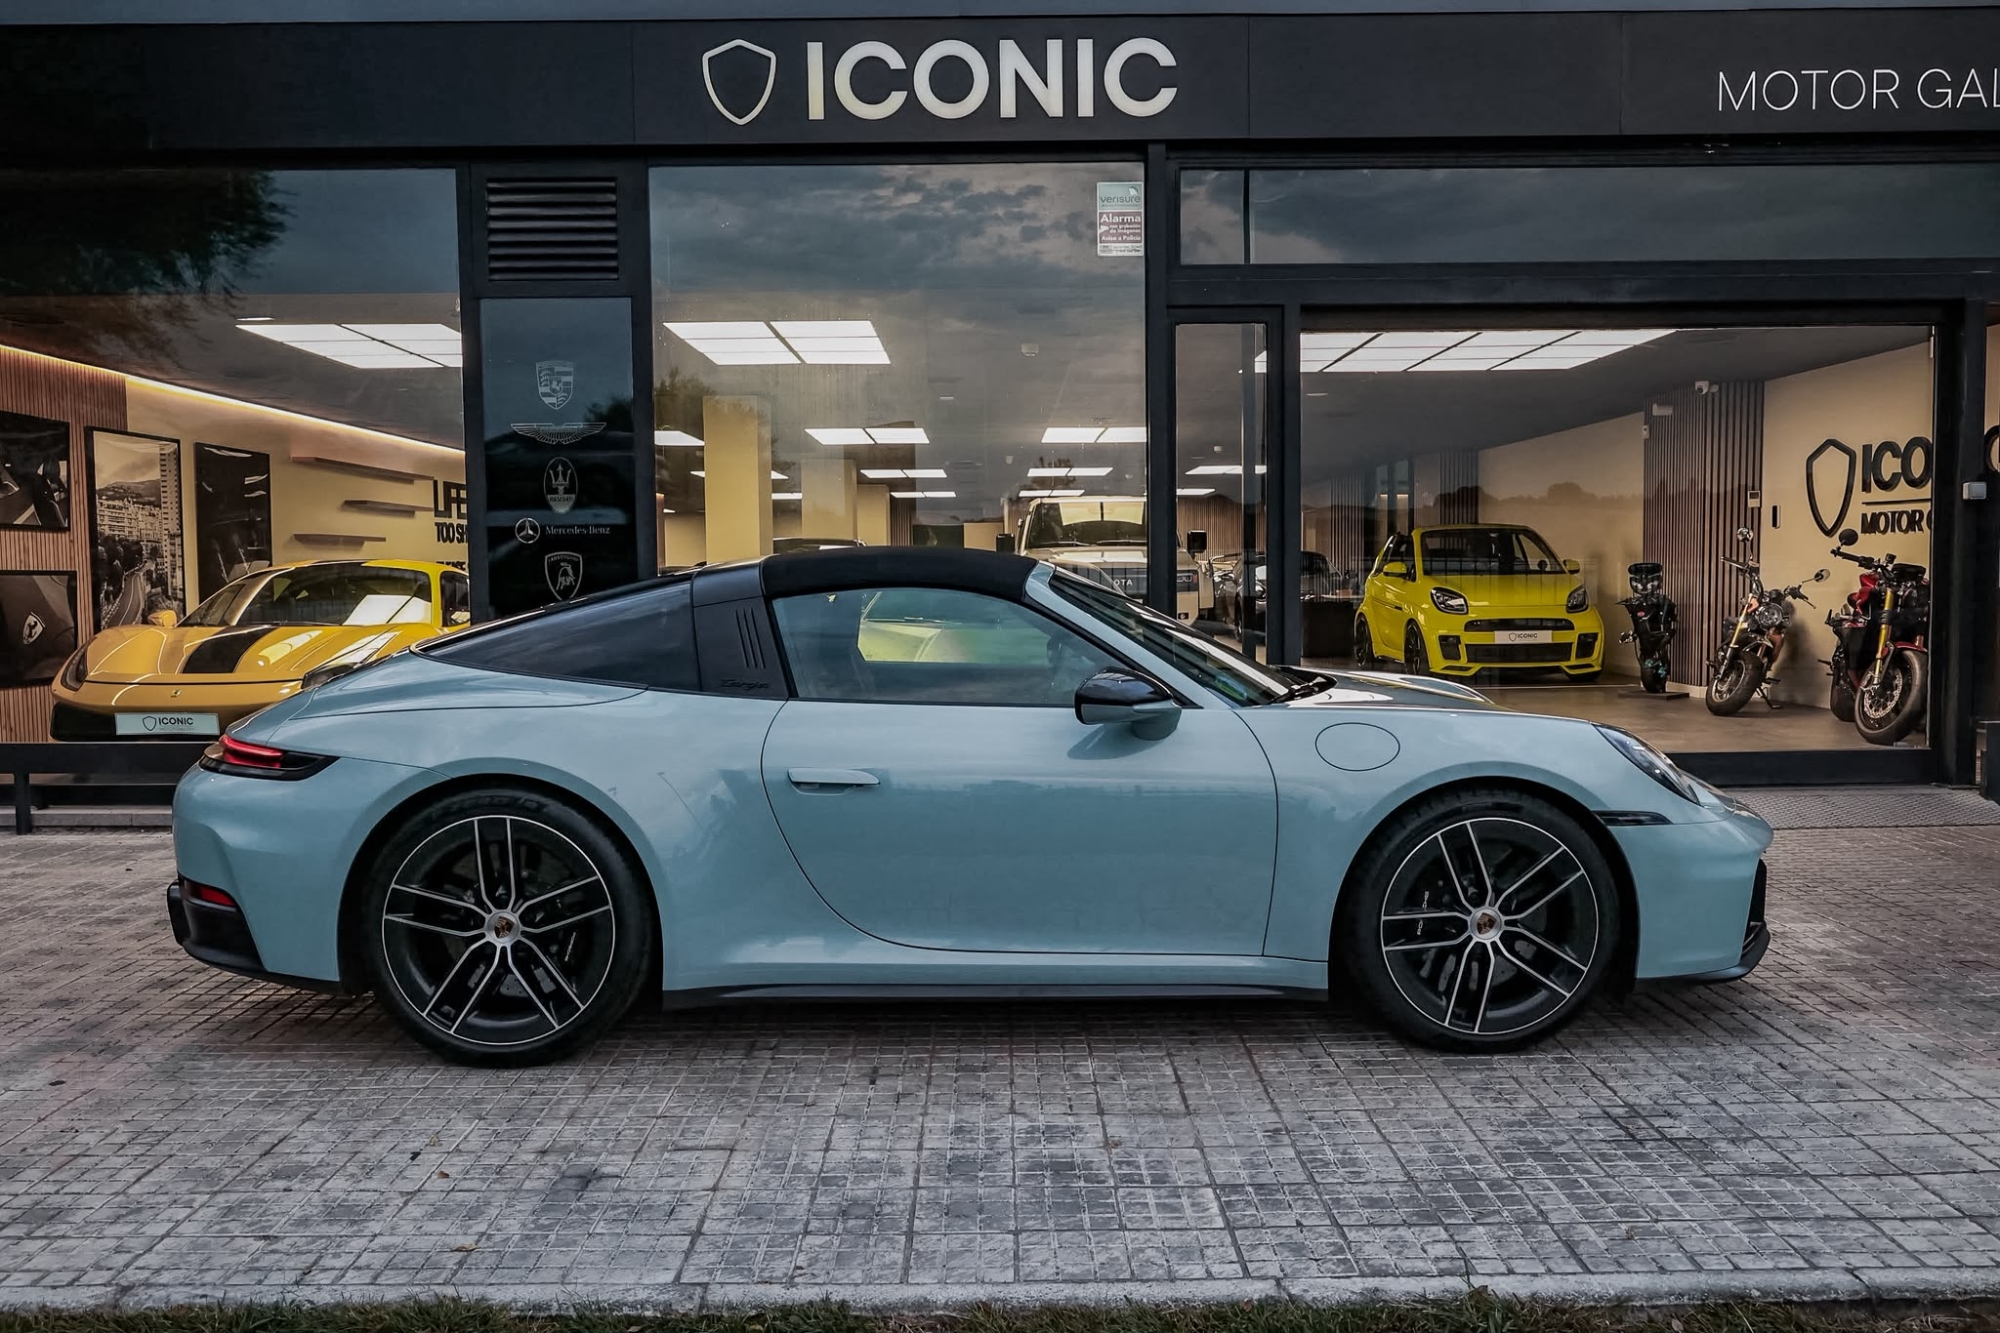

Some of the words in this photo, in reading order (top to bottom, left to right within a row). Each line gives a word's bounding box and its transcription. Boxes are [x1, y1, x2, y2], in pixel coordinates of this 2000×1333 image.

[806, 37, 1178, 120] ICONIC
[1718, 69, 1900, 111] MOTOR
[1100, 195, 1141, 203] verisure
[1100, 213, 1141, 223] Alarma
[1861, 436, 1933, 493] ICO
[435, 522, 456, 544] TOO
[546, 525, 611, 535] Mercedes-Benz
[1861, 509, 1924, 535] MOTOR
[158, 717, 194, 725] ICONIC
